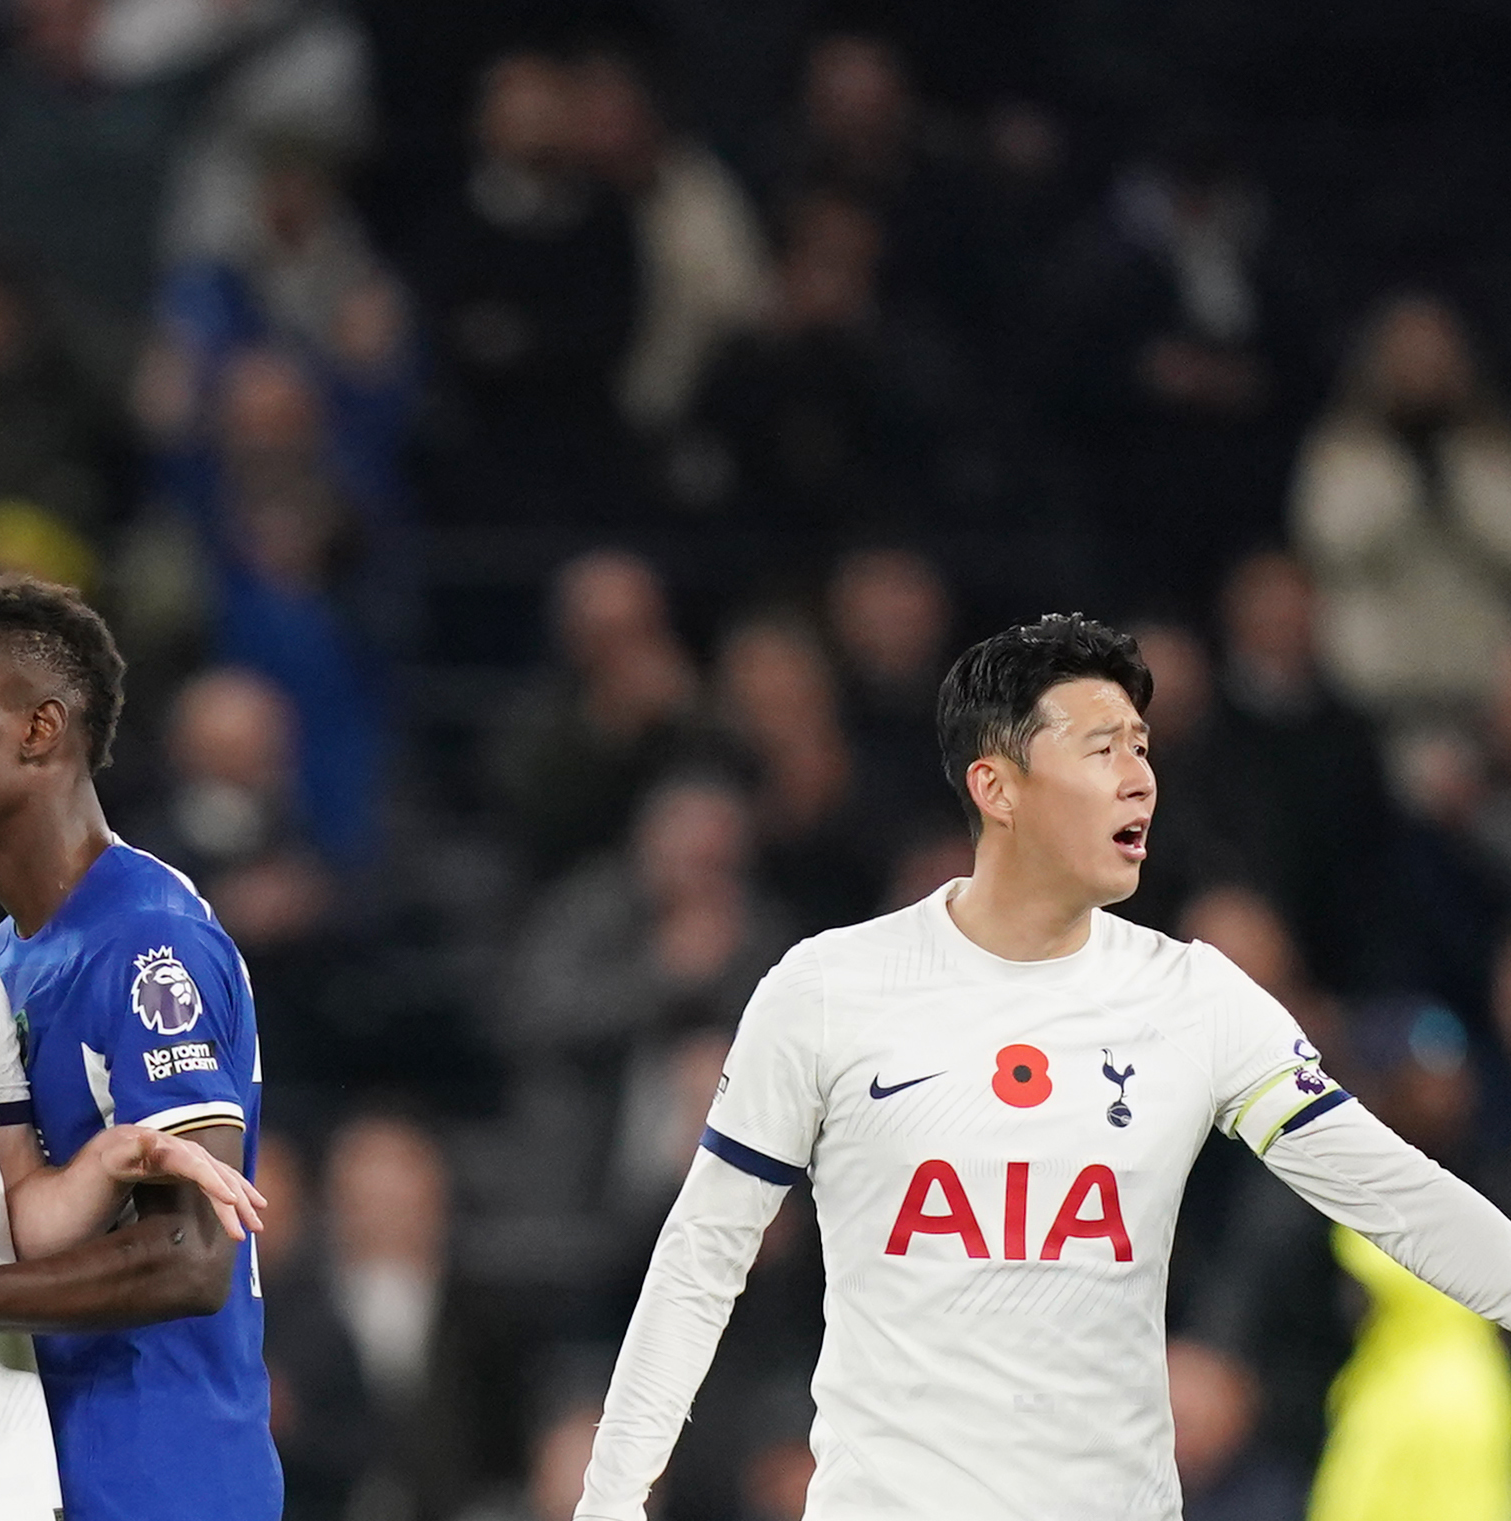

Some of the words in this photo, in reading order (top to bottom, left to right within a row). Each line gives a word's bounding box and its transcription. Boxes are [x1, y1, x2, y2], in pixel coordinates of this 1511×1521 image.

[143, 1049, 171, 1067] No
[171, 1043, 210, 1060] room
[148, 1061, 173, 1081] for
[884, 1159, 1133, 1262] AIA
